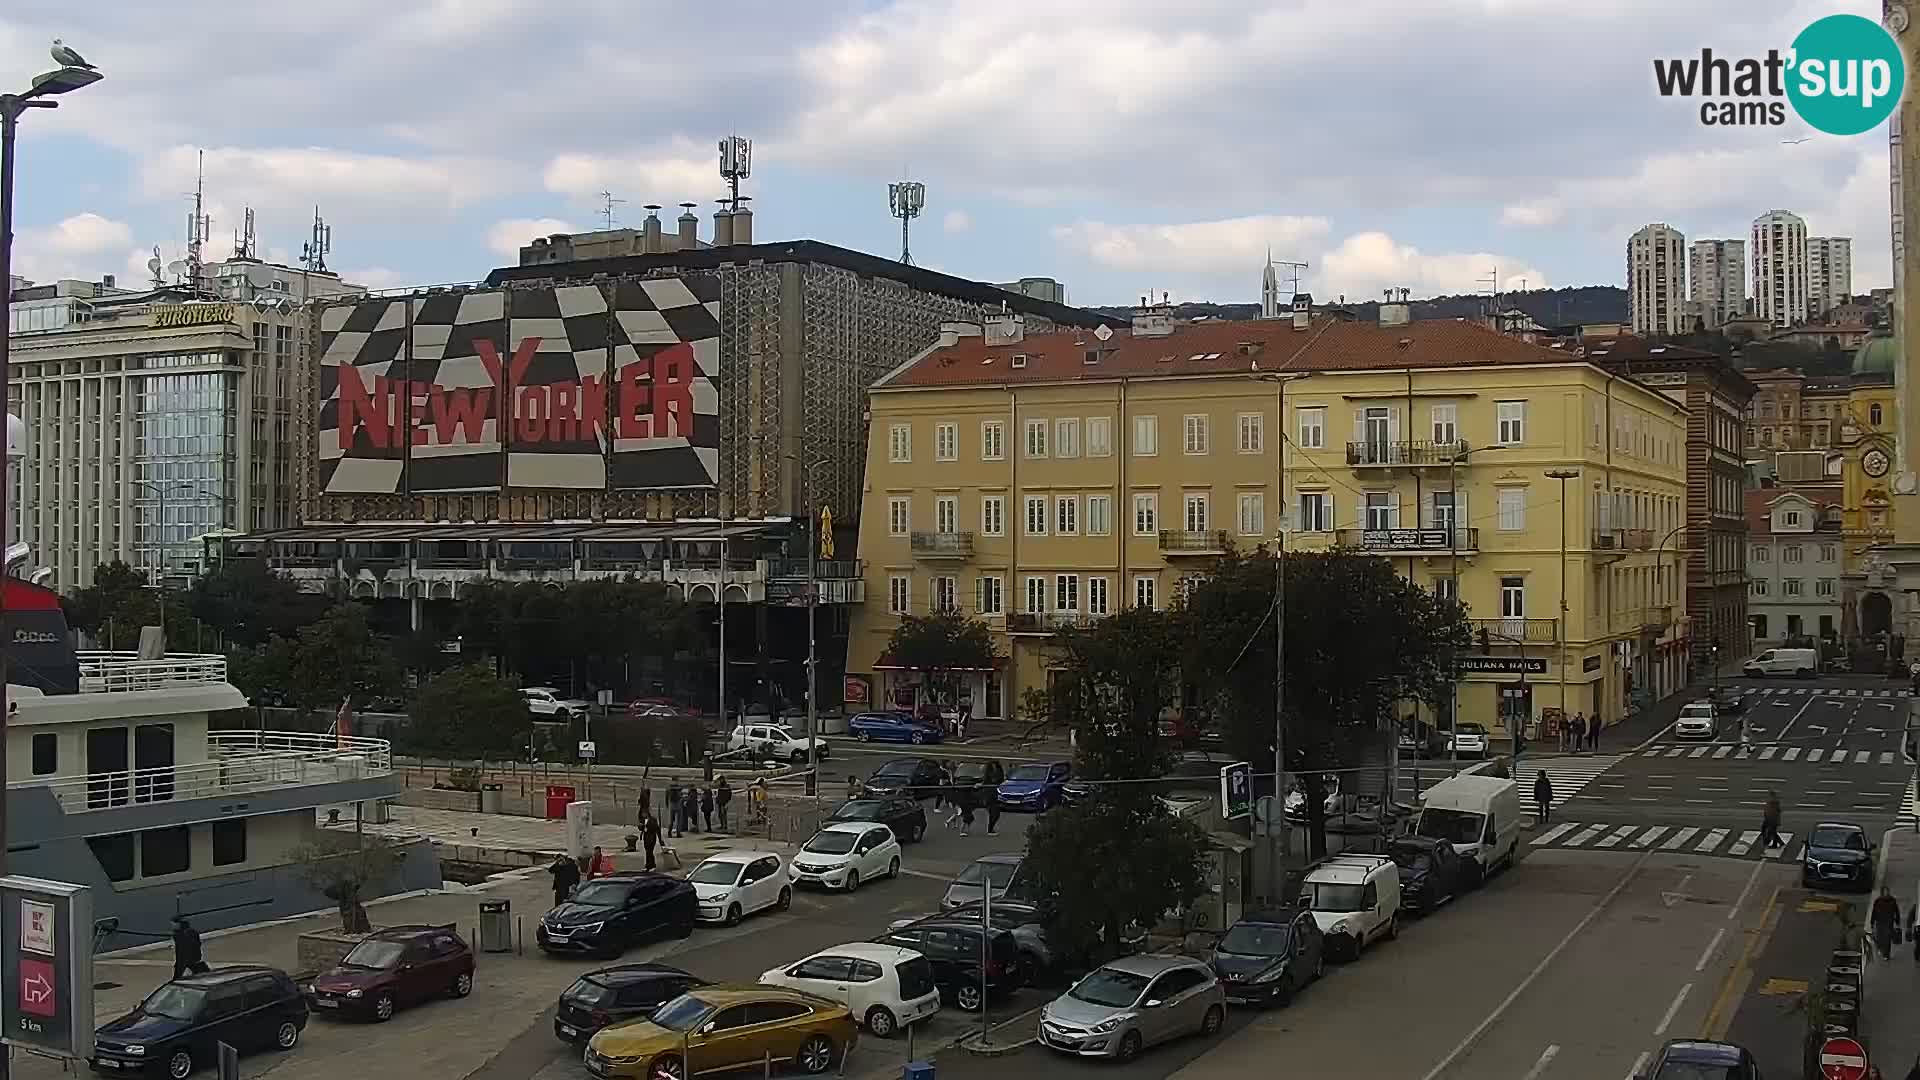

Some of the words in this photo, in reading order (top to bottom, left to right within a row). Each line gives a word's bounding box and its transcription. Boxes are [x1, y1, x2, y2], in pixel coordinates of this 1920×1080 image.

[1459, 661, 1505, 670] JULIANA
[1509, 662, 1541, 670] NAILS
[21, 1018, 27, 1030] 5
[28, 1020, 42, 1032] km
